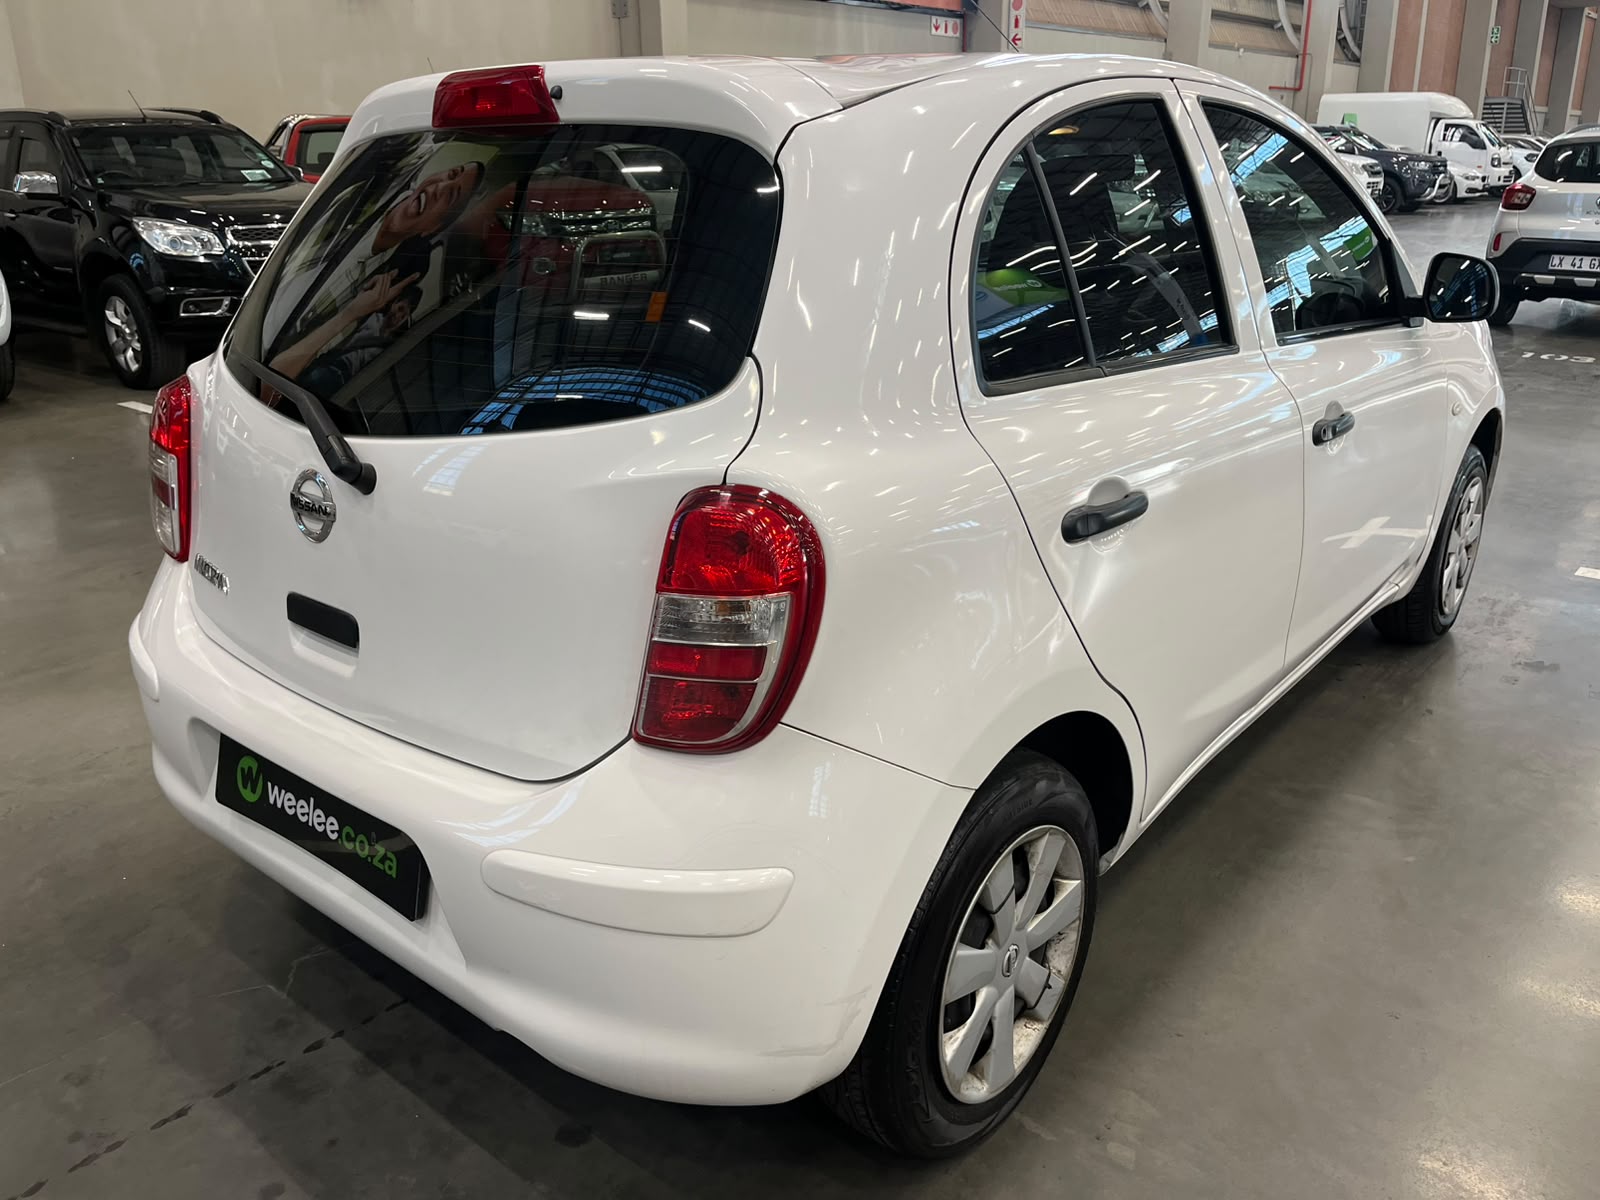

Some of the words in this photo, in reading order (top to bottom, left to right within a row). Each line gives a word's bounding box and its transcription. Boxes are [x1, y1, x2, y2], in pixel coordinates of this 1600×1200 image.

[1550, 255, 1564, 268] LX
[1570, 257, 1583, 269] 41
[600, 272, 647, 287] RANGER
[290, 493, 332, 516] NISSAN
[267, 781, 398, 879] weelee.co.za
